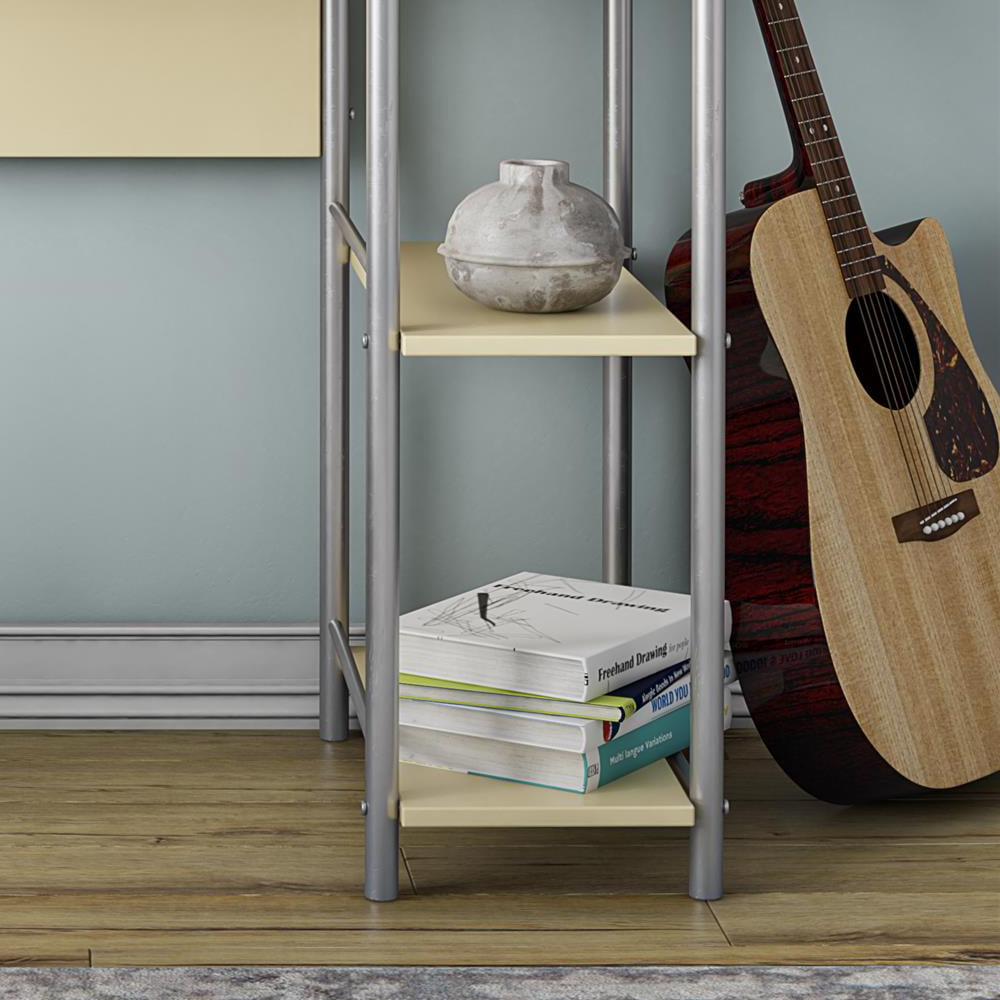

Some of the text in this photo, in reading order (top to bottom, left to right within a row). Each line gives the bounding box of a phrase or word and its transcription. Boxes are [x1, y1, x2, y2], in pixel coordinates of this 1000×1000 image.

[598, 658, 634, 682] Freehand
[636, 642, 668, 666] Drawing
[650, 692, 674, 713] WORLD
[674, 684, 689, 700] YOU
[644, 731, 673, 749] Variations
